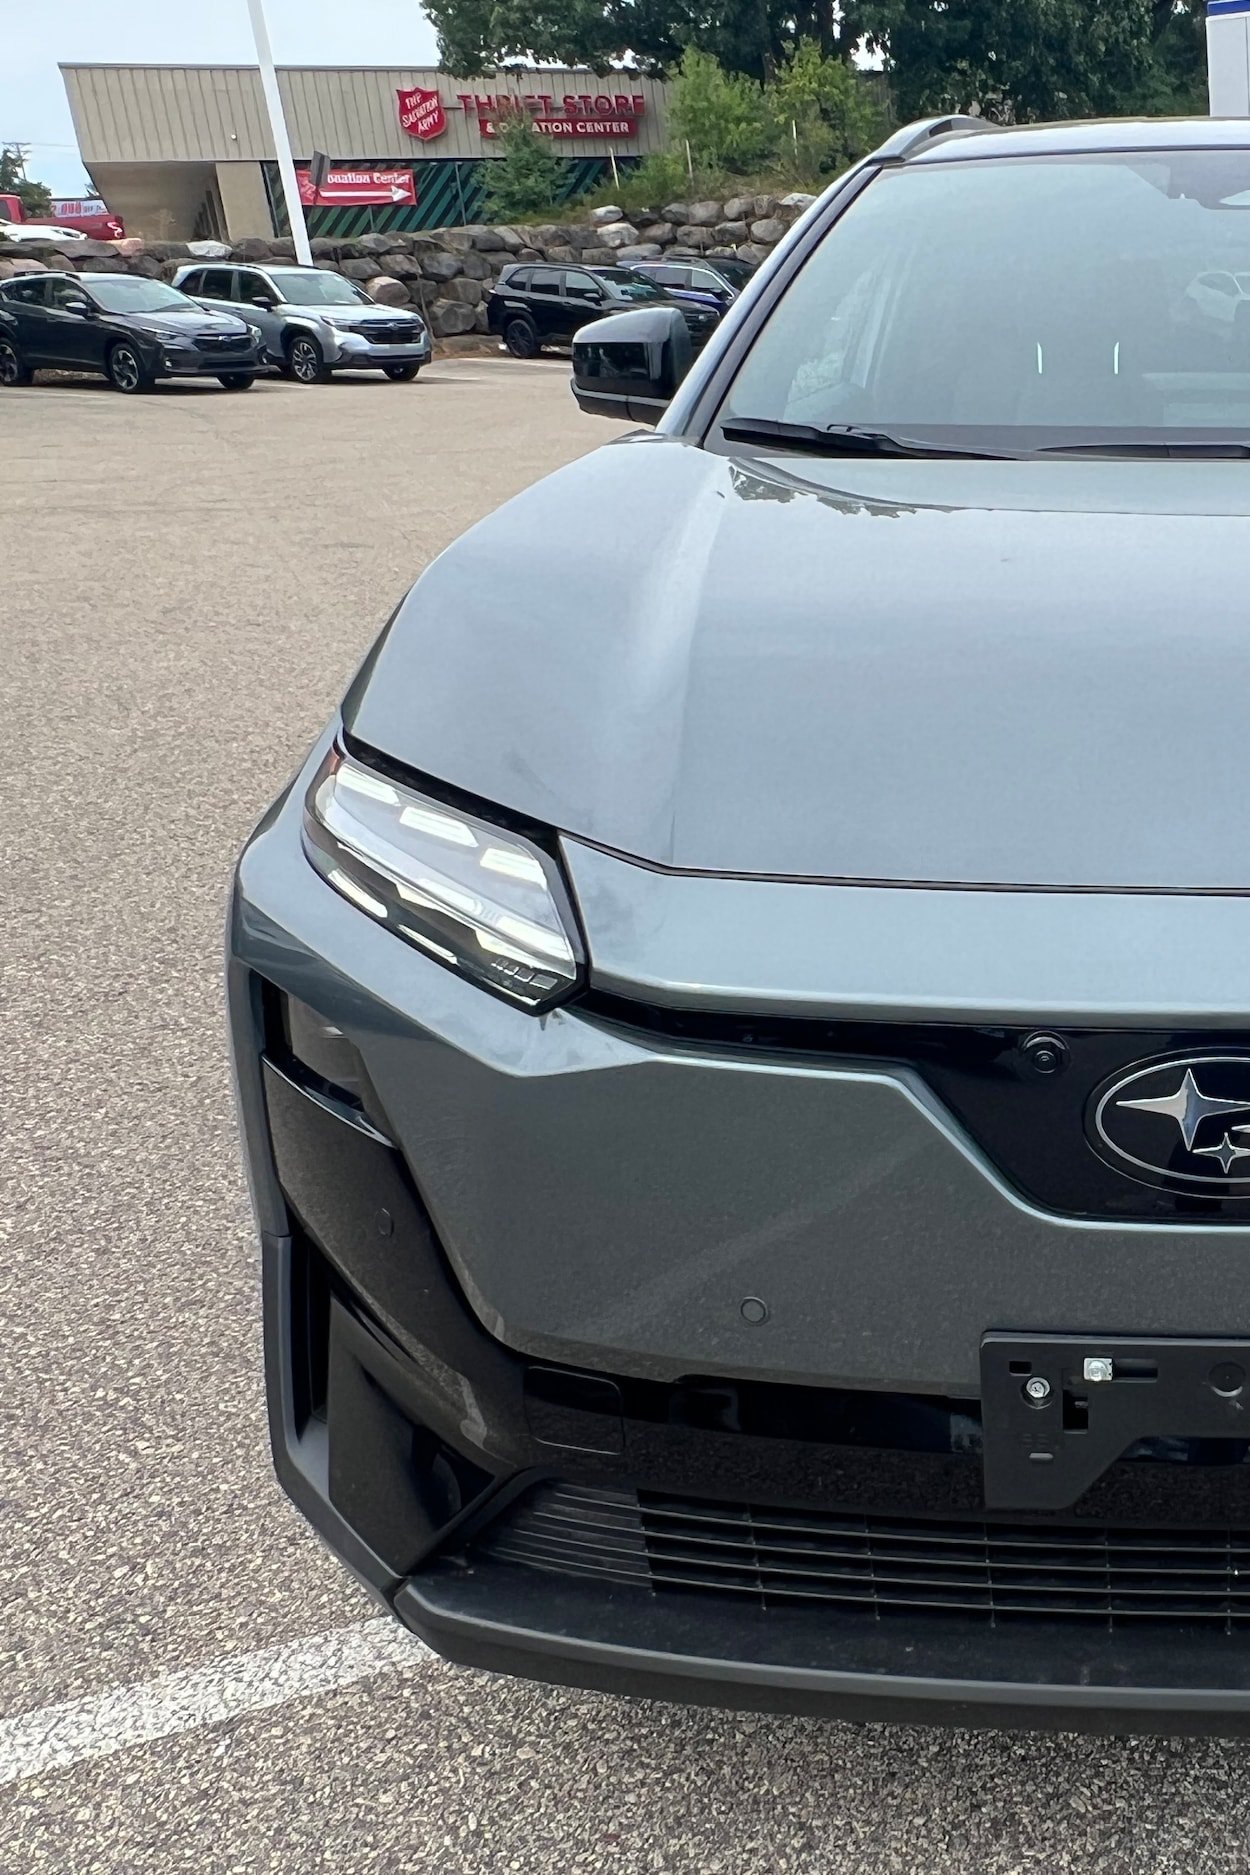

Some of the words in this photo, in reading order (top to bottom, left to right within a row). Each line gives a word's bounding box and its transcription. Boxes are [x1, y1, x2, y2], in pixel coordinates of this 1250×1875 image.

[562, 94, 645, 115] STORE
[417, 110, 439, 134] ARMY
[499, 122, 573, 133] DATION
[576, 122, 629, 133] CENTER
[327, 173, 371, 184] onation
[373, 172, 411, 184] Center
